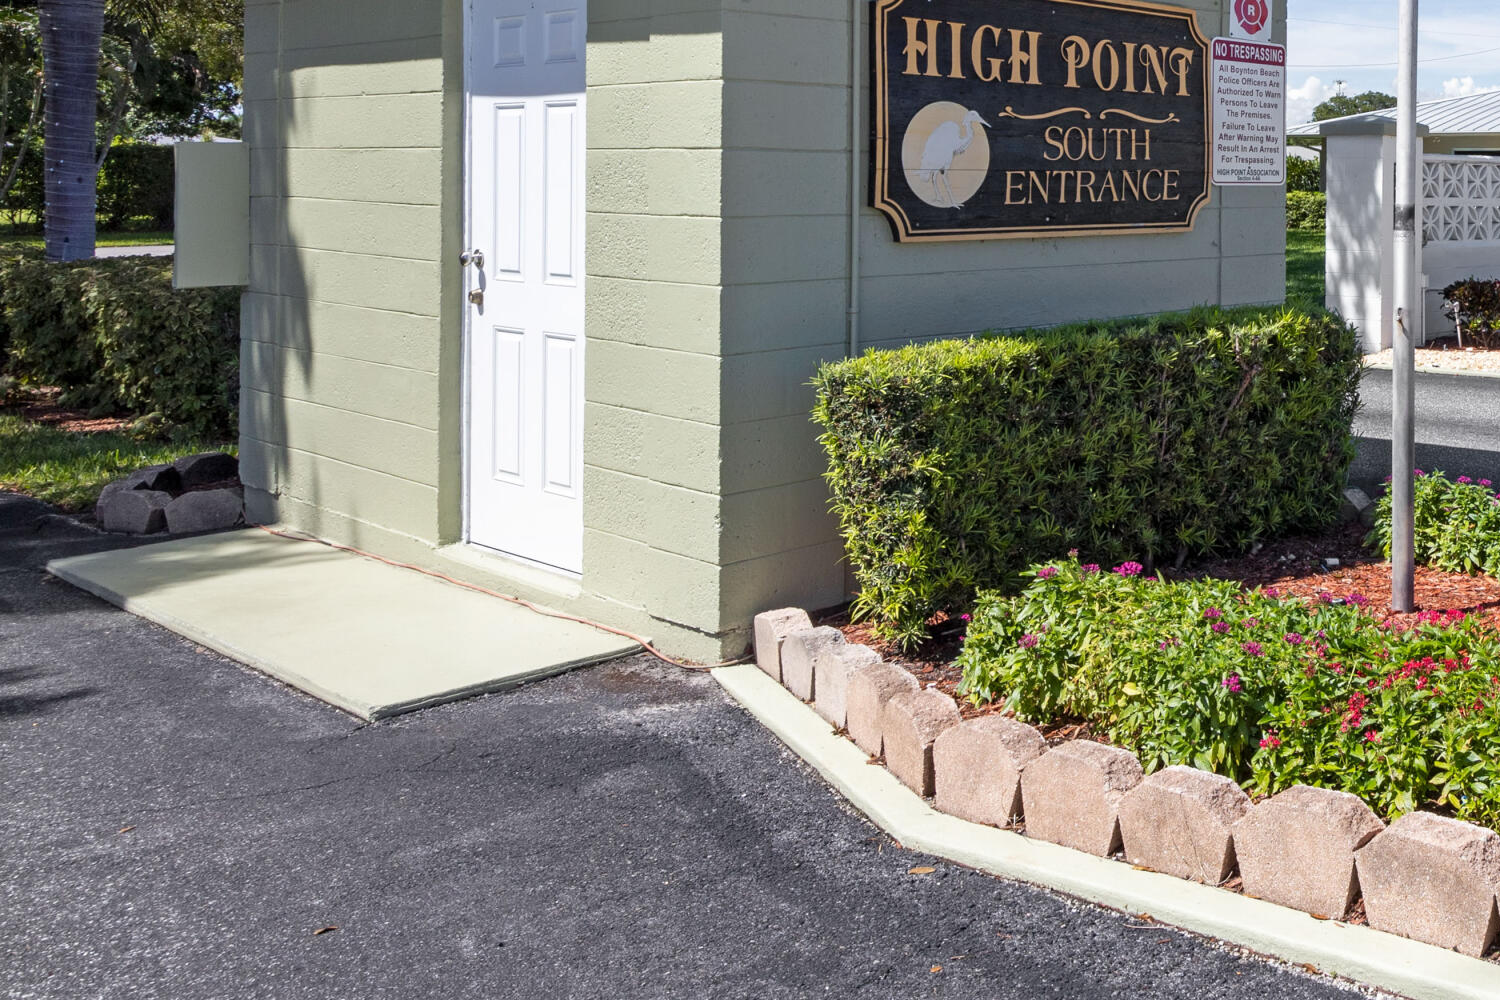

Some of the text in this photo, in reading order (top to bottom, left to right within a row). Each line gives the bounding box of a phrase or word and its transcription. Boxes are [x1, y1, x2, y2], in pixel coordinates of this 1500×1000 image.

[902, 17, 1194, 96] HIGH POINT
[1215, 42, 1283, 62] NO TRESPASSING
[1230, 66, 1258, 75] Boynton
[1260, 68, 1280, 77] Beach
[1219, 76, 1280, 88] Police Officers Are
[1217, 87, 1281, 98] Authorized To Warn
[1220, 98, 1278, 109] Persons To Leave
[1226, 109, 1272, 120] The Premises.
[1222, 122, 1276, 132] Failure To Leave
[1043, 126, 1151, 161] SOUTH
[1219, 133, 1279, 145] After Warning May
[1218, 144, 1239, 152] Result
[1249, 145, 1258, 153] An
[1260, 145, 1280, 154] Arrest
[1221, 155, 1233, 163] For
[1247, 169, 1280, 177] ASSOCIATION
[1004, 168, 1181, 205] ENTRANCE
